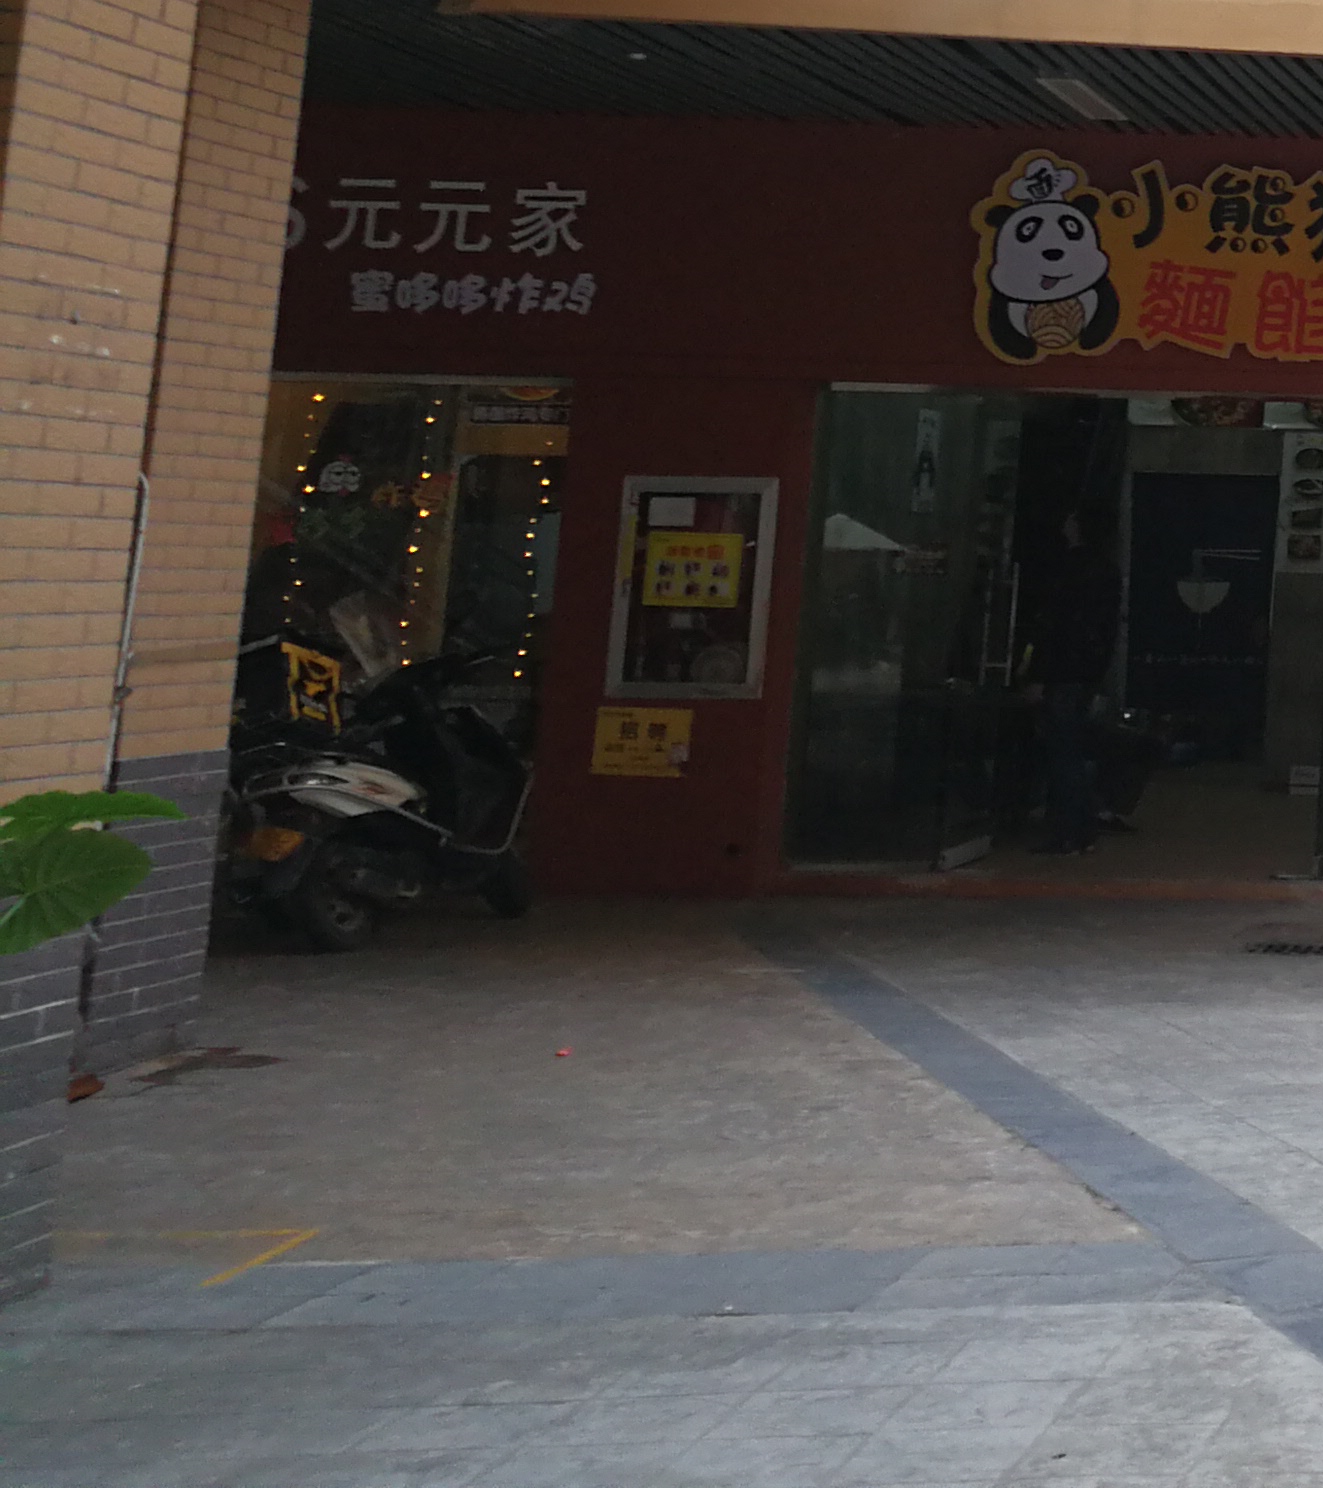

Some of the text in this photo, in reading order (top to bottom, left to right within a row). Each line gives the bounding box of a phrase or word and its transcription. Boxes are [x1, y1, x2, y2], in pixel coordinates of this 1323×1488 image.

[350, 268, 599, 315] 蜜哆哆炸鸡
